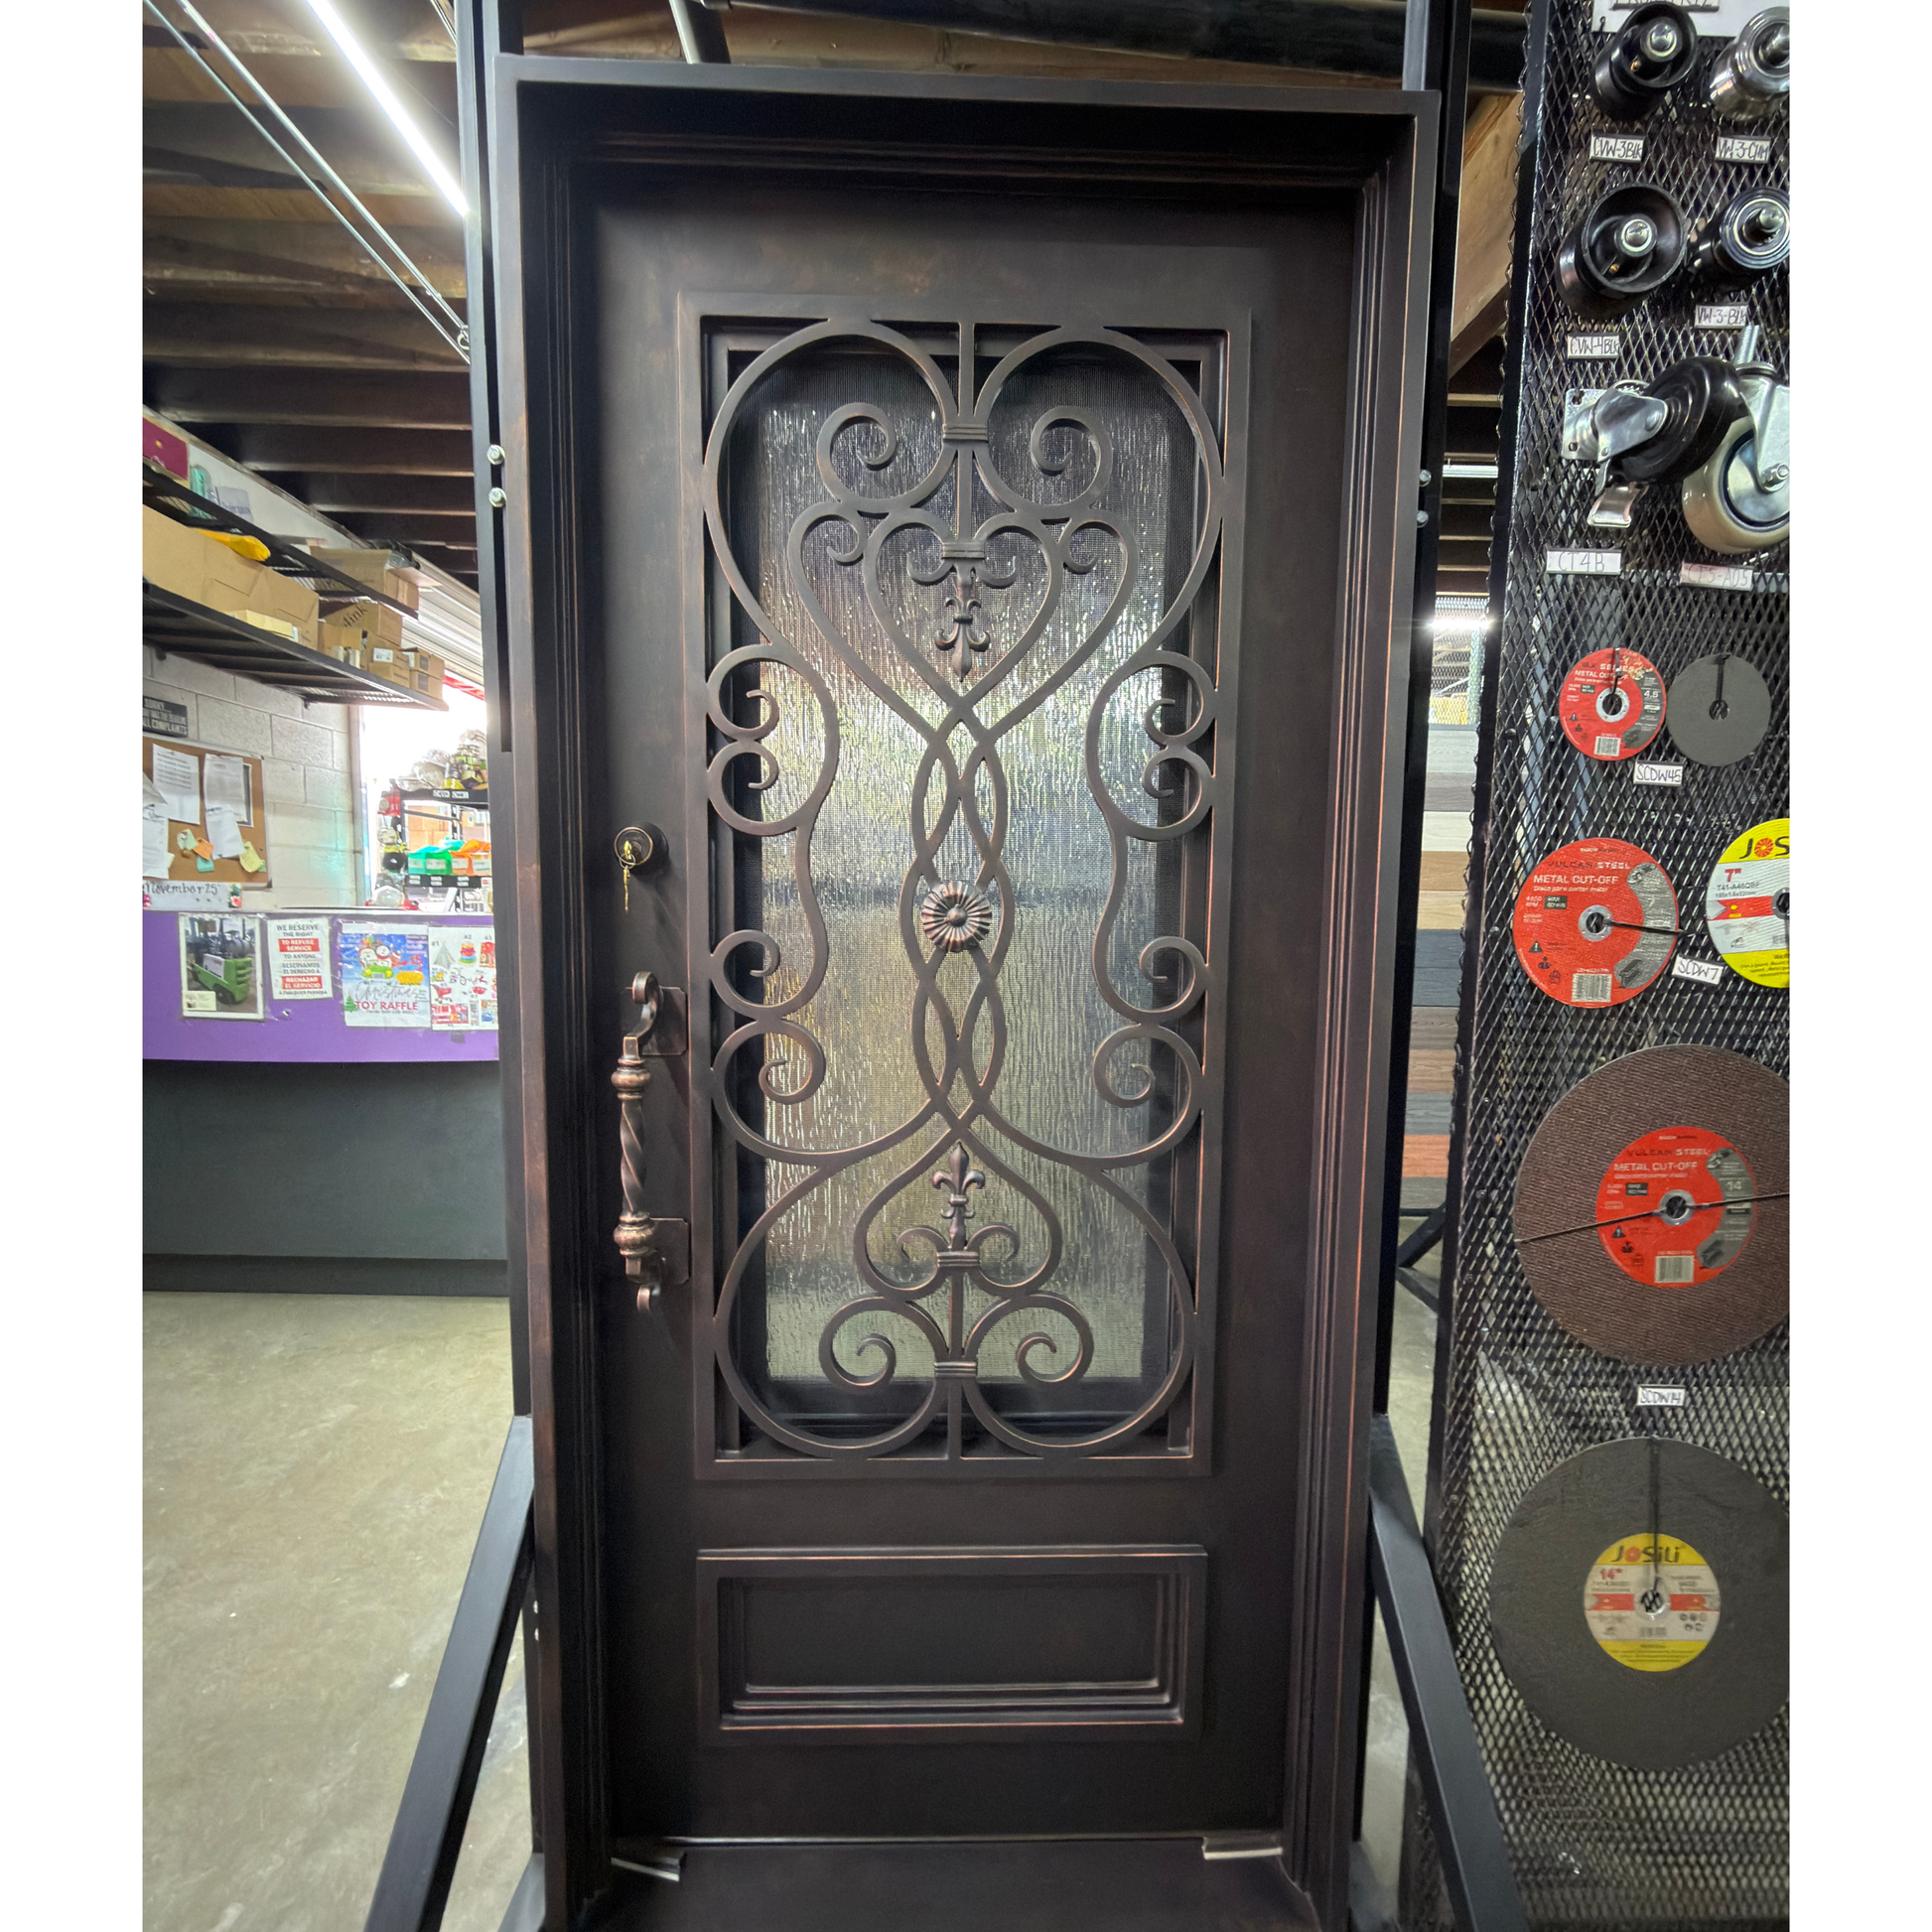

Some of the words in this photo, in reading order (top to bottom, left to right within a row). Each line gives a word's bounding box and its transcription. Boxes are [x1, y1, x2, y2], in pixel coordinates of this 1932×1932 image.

[1575, 669, 1598, 678] METAL
[1636, 763, 1683, 783] SCDW45
[1547, 861, 1593, 870] VULCAN
[1595, 861, 1631, 870] STEEL
[1533, 875, 1570, 884] METAL
[1572, 875, 1619, 885] CUT-OFF
[1677, 959, 1720, 981] SCDW7
[354, 1001, 377, 1010] TOY
[379, 1001, 419, 1011] RAFFLE
[1613, 1163, 1650, 1172] METAL
[1651, 1161, 1698, 1171] CUT-OFF
